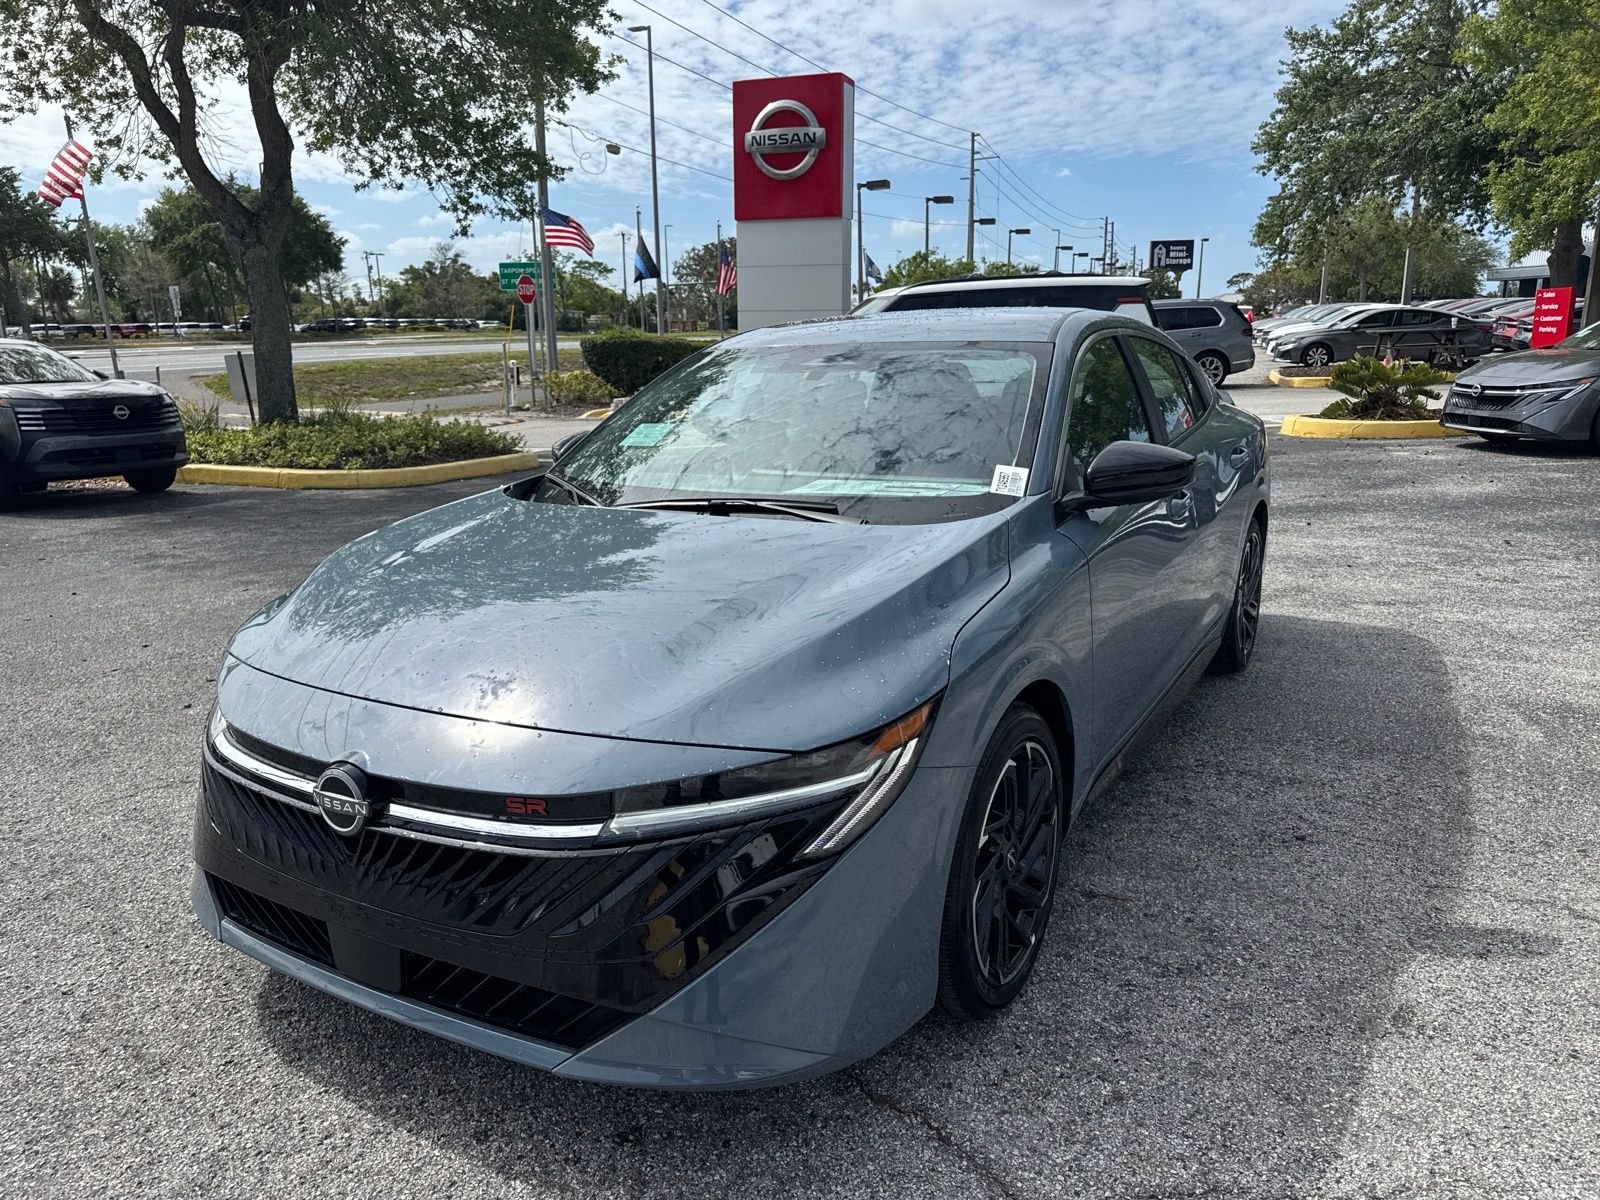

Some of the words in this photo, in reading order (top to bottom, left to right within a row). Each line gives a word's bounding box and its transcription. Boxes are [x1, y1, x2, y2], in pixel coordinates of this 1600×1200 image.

[751, 132, 816, 147] NISSAN
[519, 284, 535, 295] STOP
[313, 791, 366, 815] NISSAN
[505, 796, 548, 816] SR
